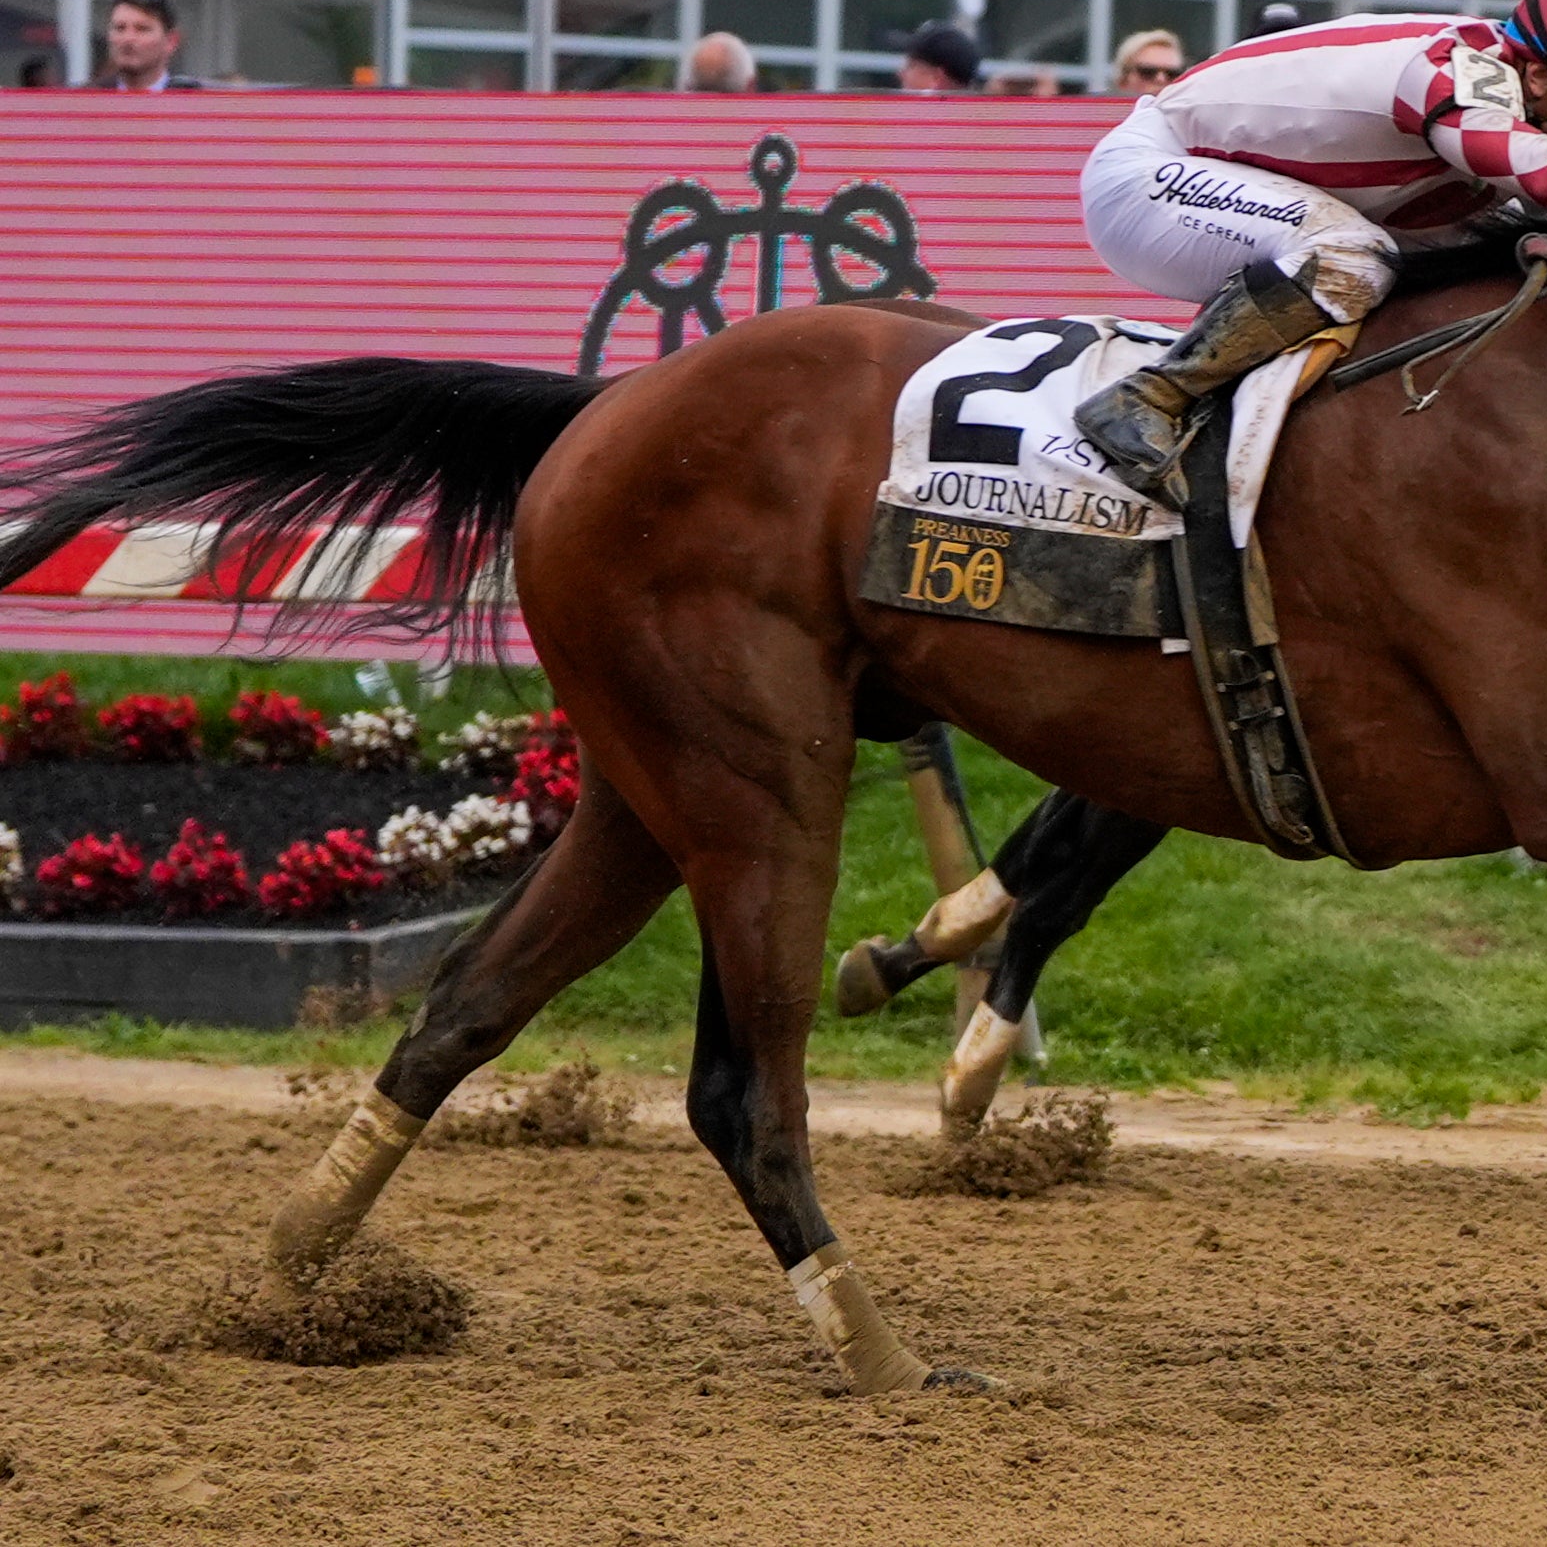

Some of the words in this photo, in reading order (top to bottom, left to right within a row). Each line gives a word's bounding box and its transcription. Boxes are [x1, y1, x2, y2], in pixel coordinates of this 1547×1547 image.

[1149, 162, 1308, 227] Hildebrandt's
[1177, 214, 1202, 230] ICE
[1205, 222, 1257, 249] CREAM
[929, 318, 1102, 466] 2
[912, 517, 1011, 548] PREAKNESS
[915, 470, 1152, 536] JOURNALISM
[901, 538, 1005, 610] 150
